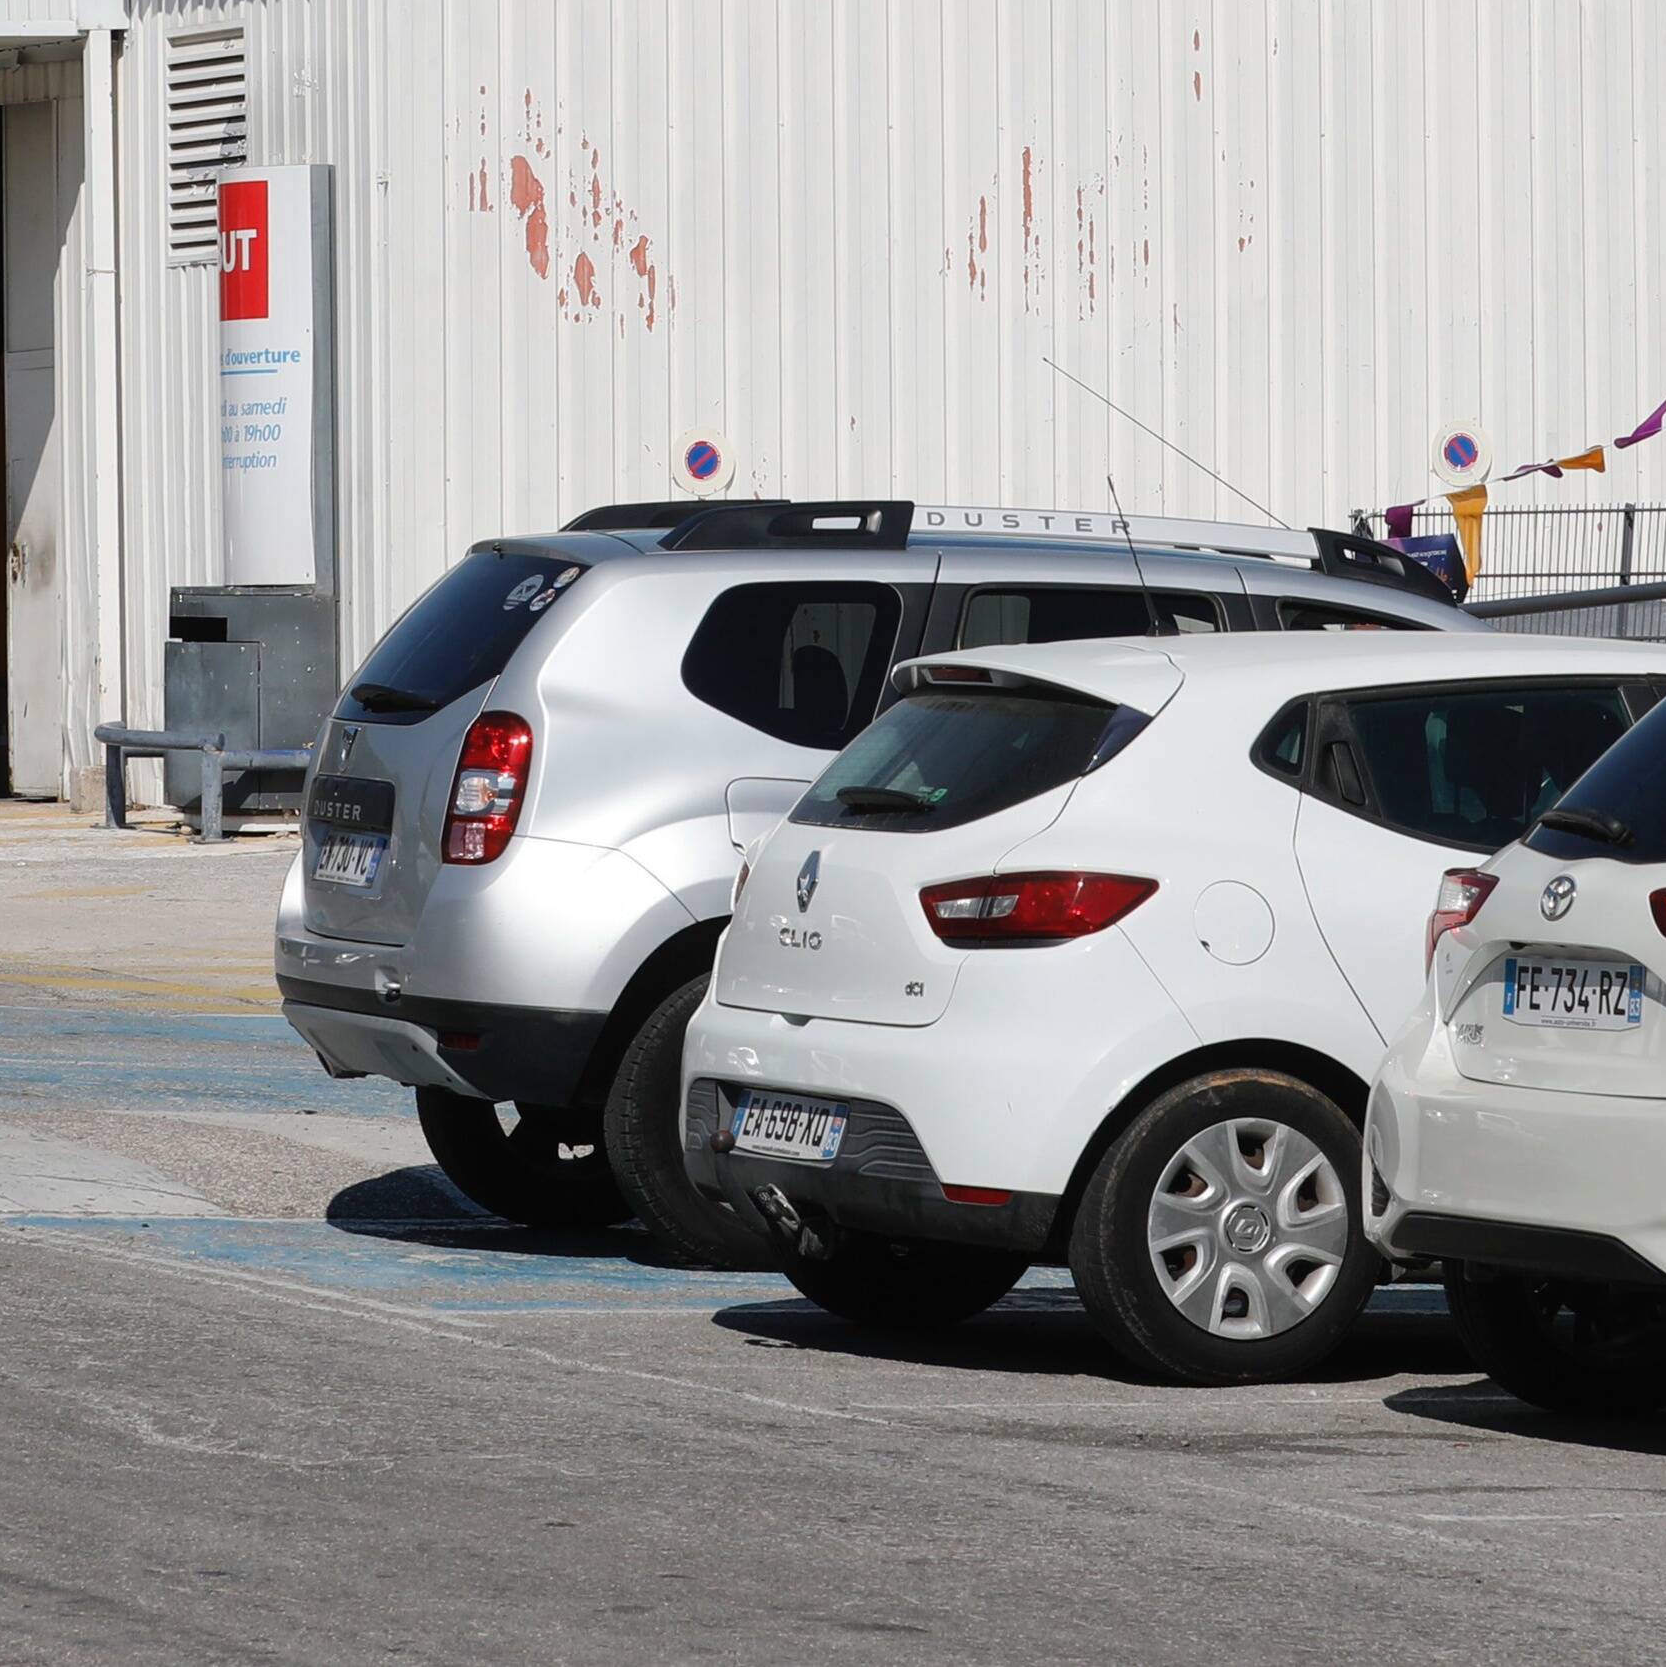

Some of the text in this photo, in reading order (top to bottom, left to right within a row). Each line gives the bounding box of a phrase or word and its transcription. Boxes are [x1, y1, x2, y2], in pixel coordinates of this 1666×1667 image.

[221, 228, 258, 273] UT
[241, 396, 287, 416] samedi
[244, 423, 282, 442] 19h00
[926, 511, 1131, 535] DUSTER
[313, 799, 362, 821] DUSTER
[779, 927, 823, 951] CLIO
[1515, 965, 1629, 1016] FE-734-RZ
[742, 1097, 830, 1148] EA-698-XQ
